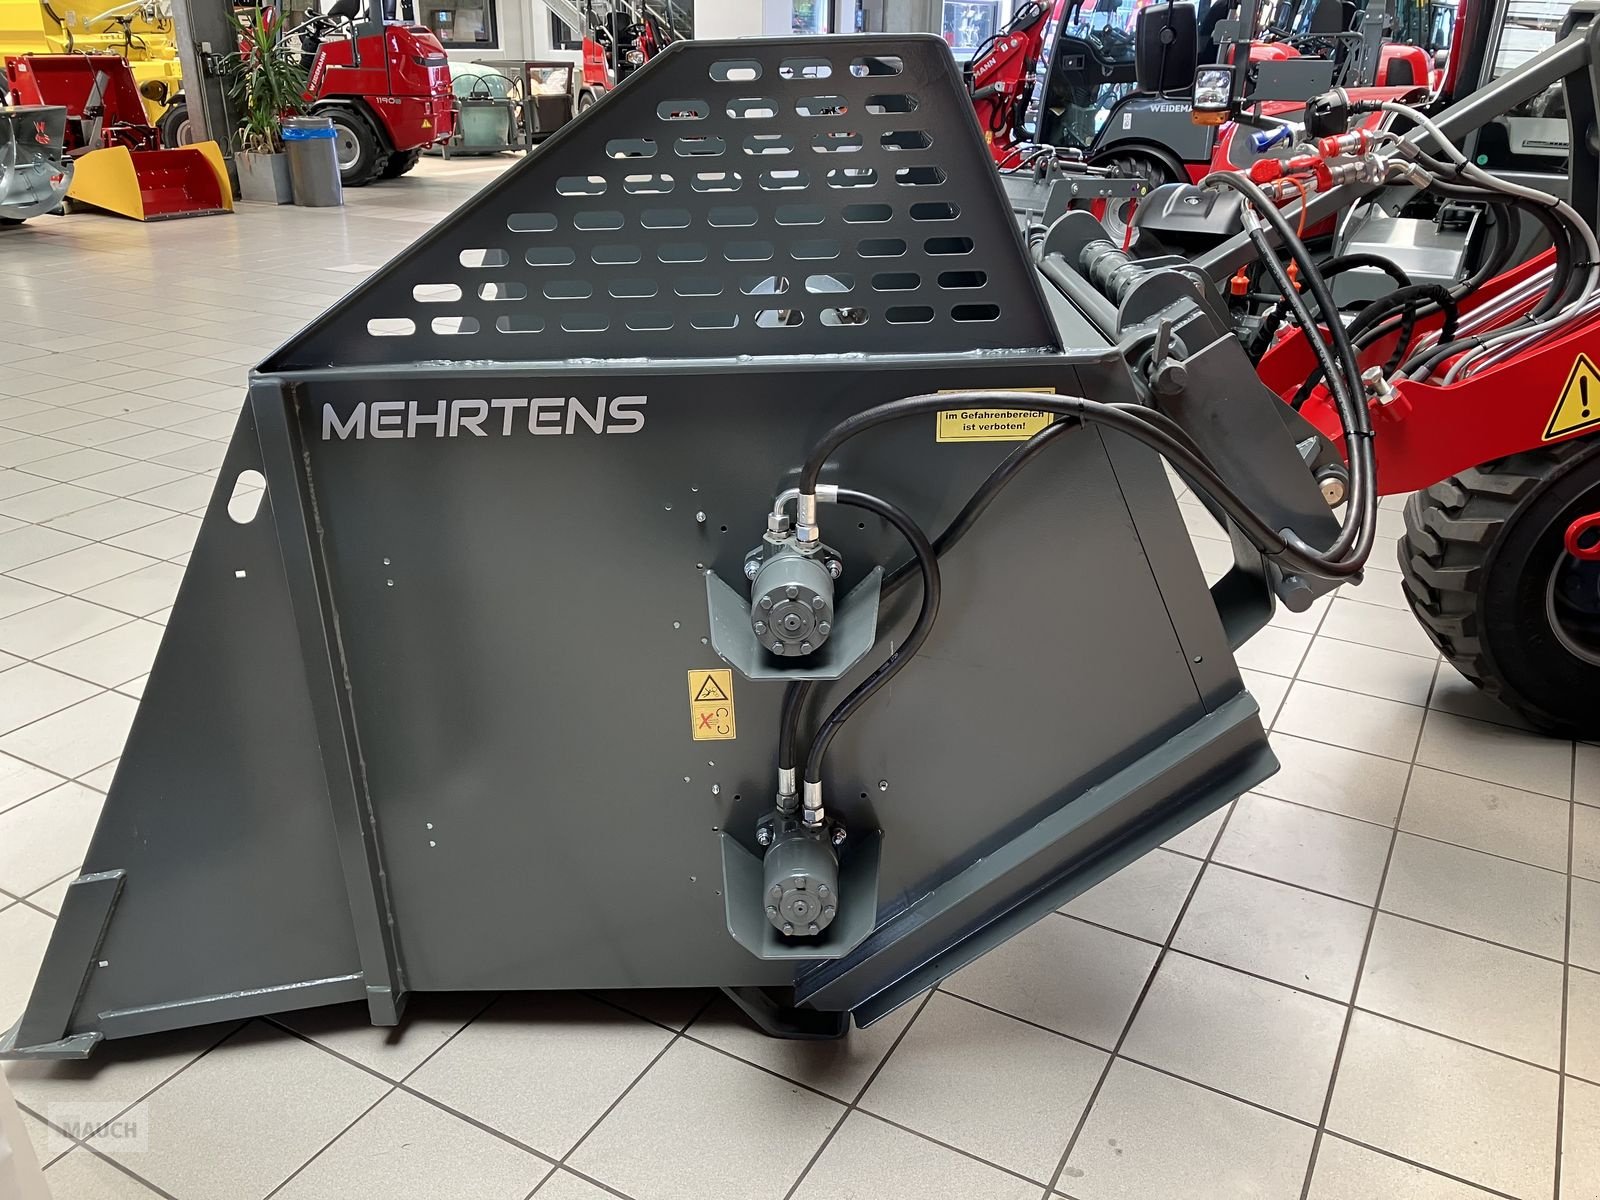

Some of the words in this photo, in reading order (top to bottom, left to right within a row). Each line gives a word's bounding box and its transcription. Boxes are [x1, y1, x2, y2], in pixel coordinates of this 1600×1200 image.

[973, 57, 997, 79] MANN
[1150, 104, 1194, 113] WEIDEMA
[322, 395, 648, 440] MEHRTENS
[945, 412, 958, 420] im
[960, 410, 1045, 420] Gefahrenbereich
[962, 423, 976, 431] ist
[978, 422, 1026, 431] verboten!
